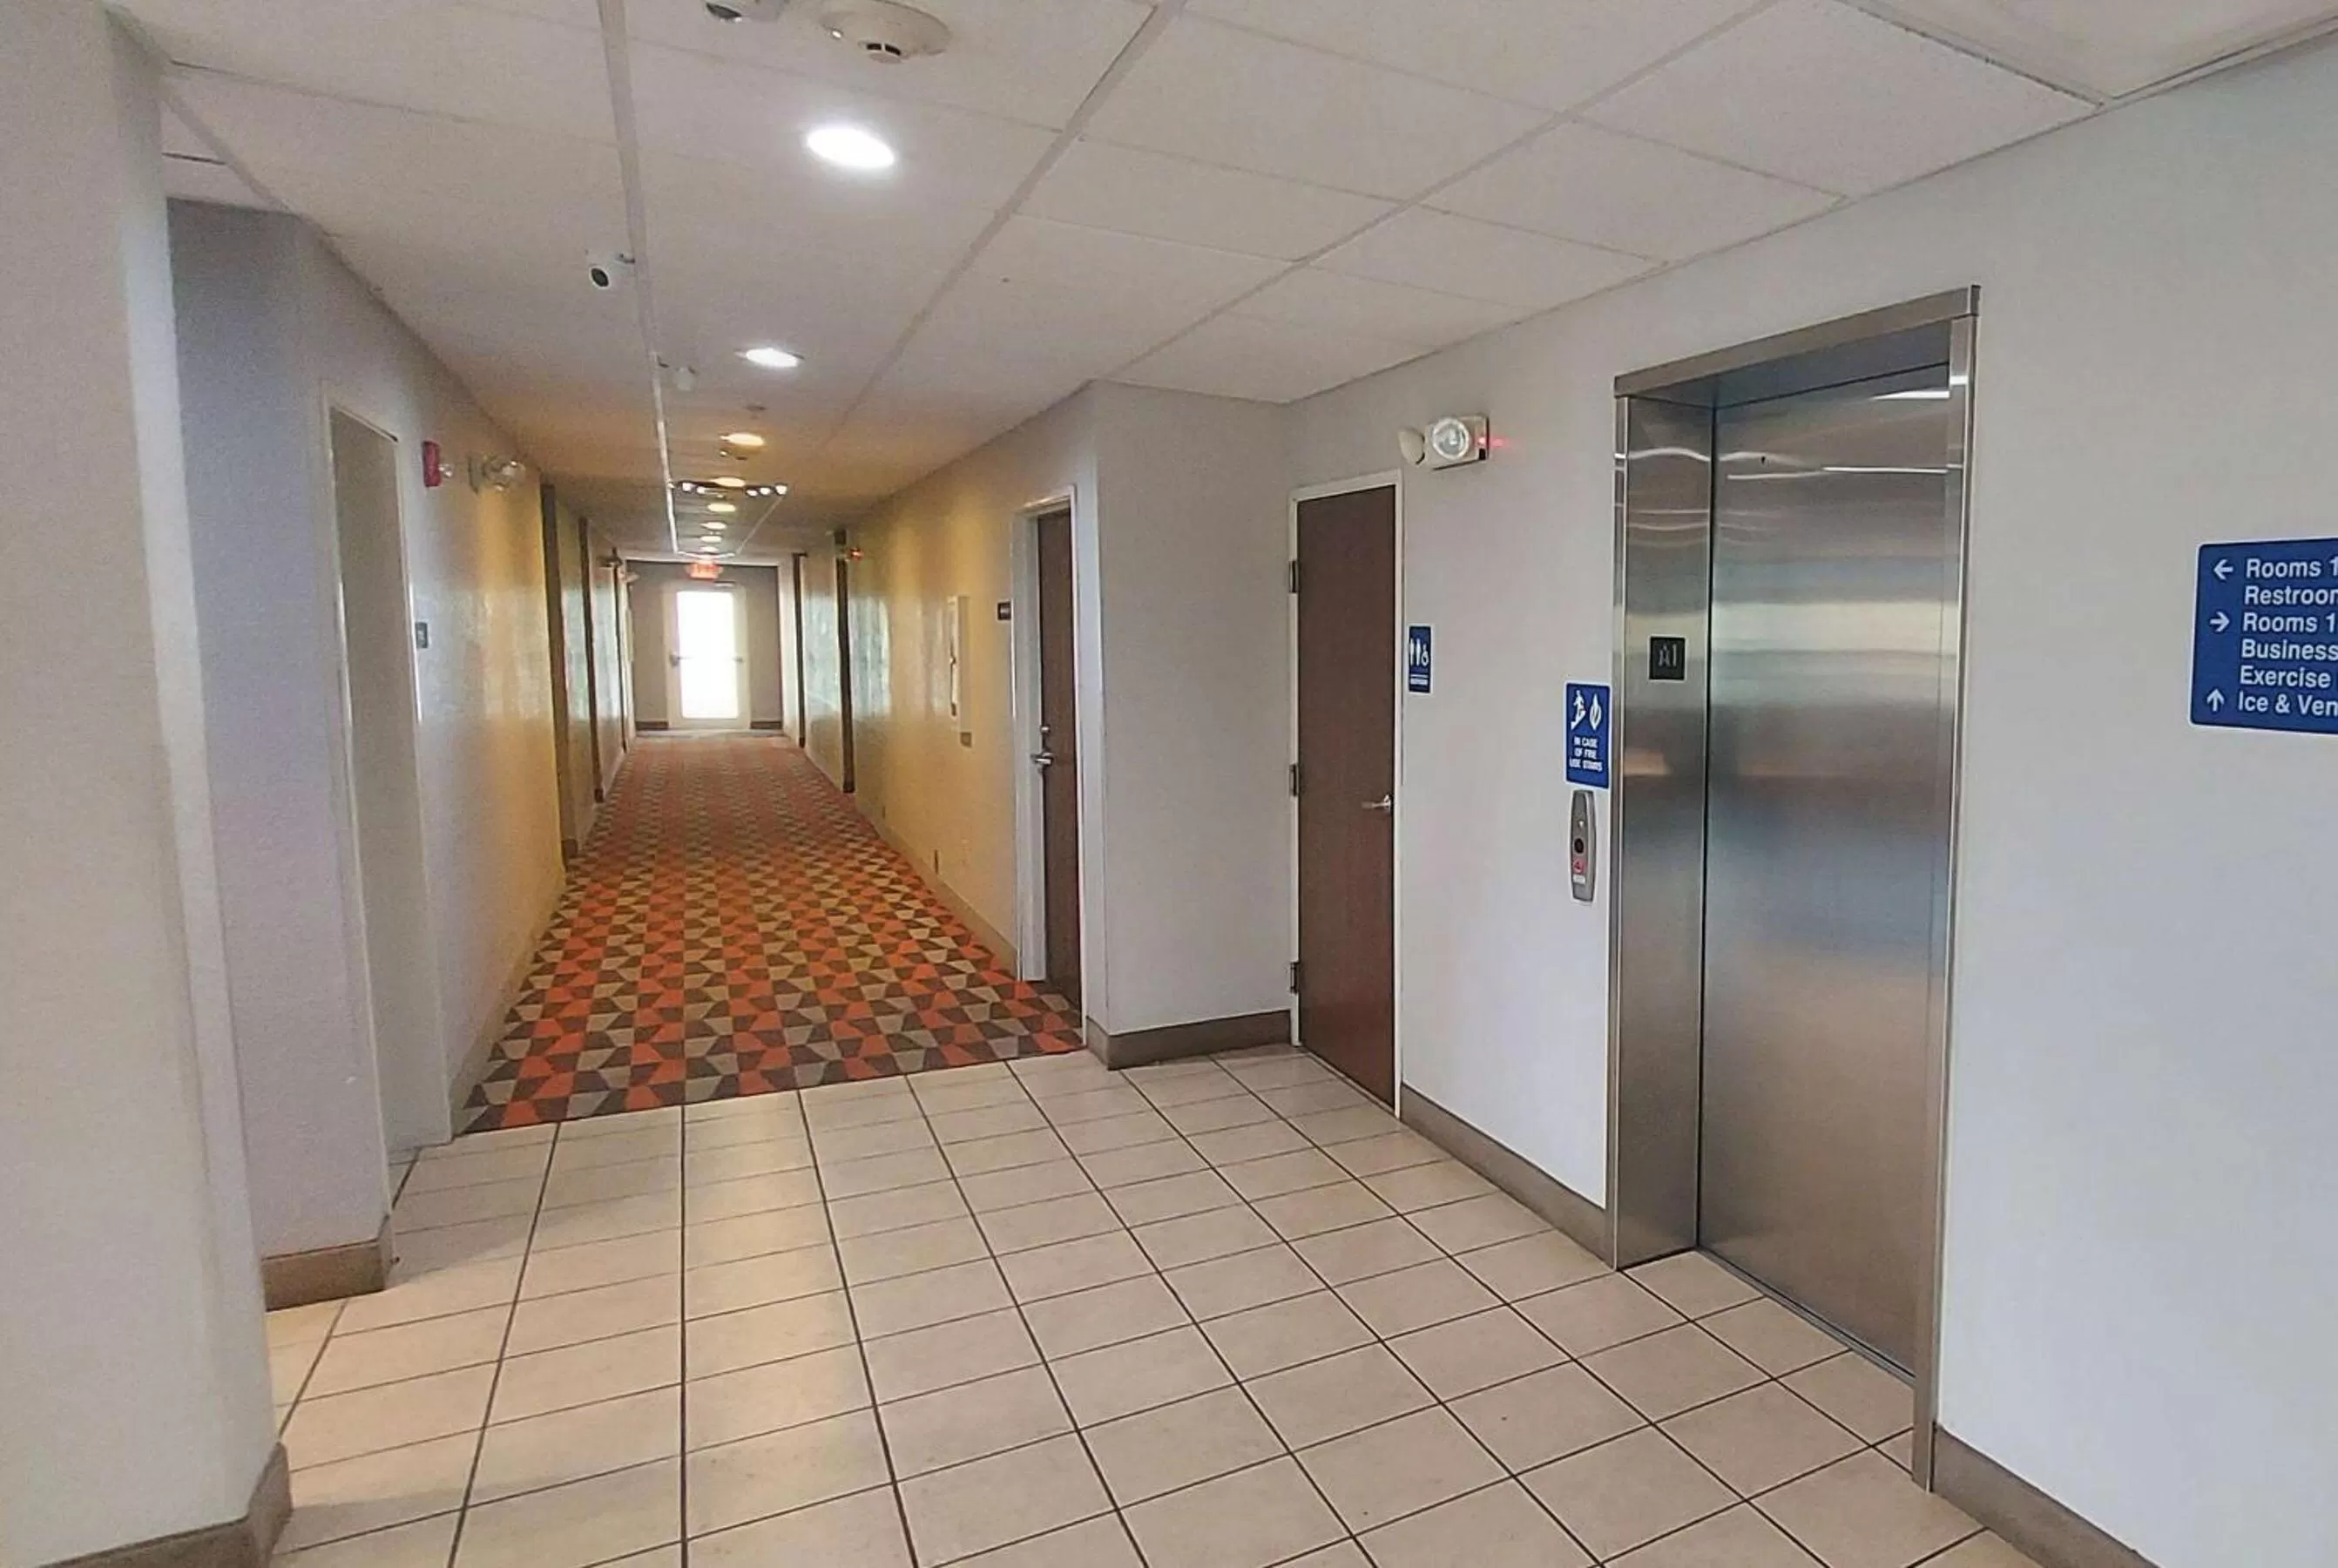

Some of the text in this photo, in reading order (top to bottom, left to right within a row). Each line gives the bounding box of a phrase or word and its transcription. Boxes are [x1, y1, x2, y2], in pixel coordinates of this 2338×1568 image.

[2246, 558, 2321, 578] Rooms
[2242, 612, 2335, 632] Rooms 1
[2241, 639, 2338, 661] Business
[2240, 665, 2331, 688] Exercise
[2238, 691, 2268, 712] Ice
[2275, 693, 2290, 713] &
